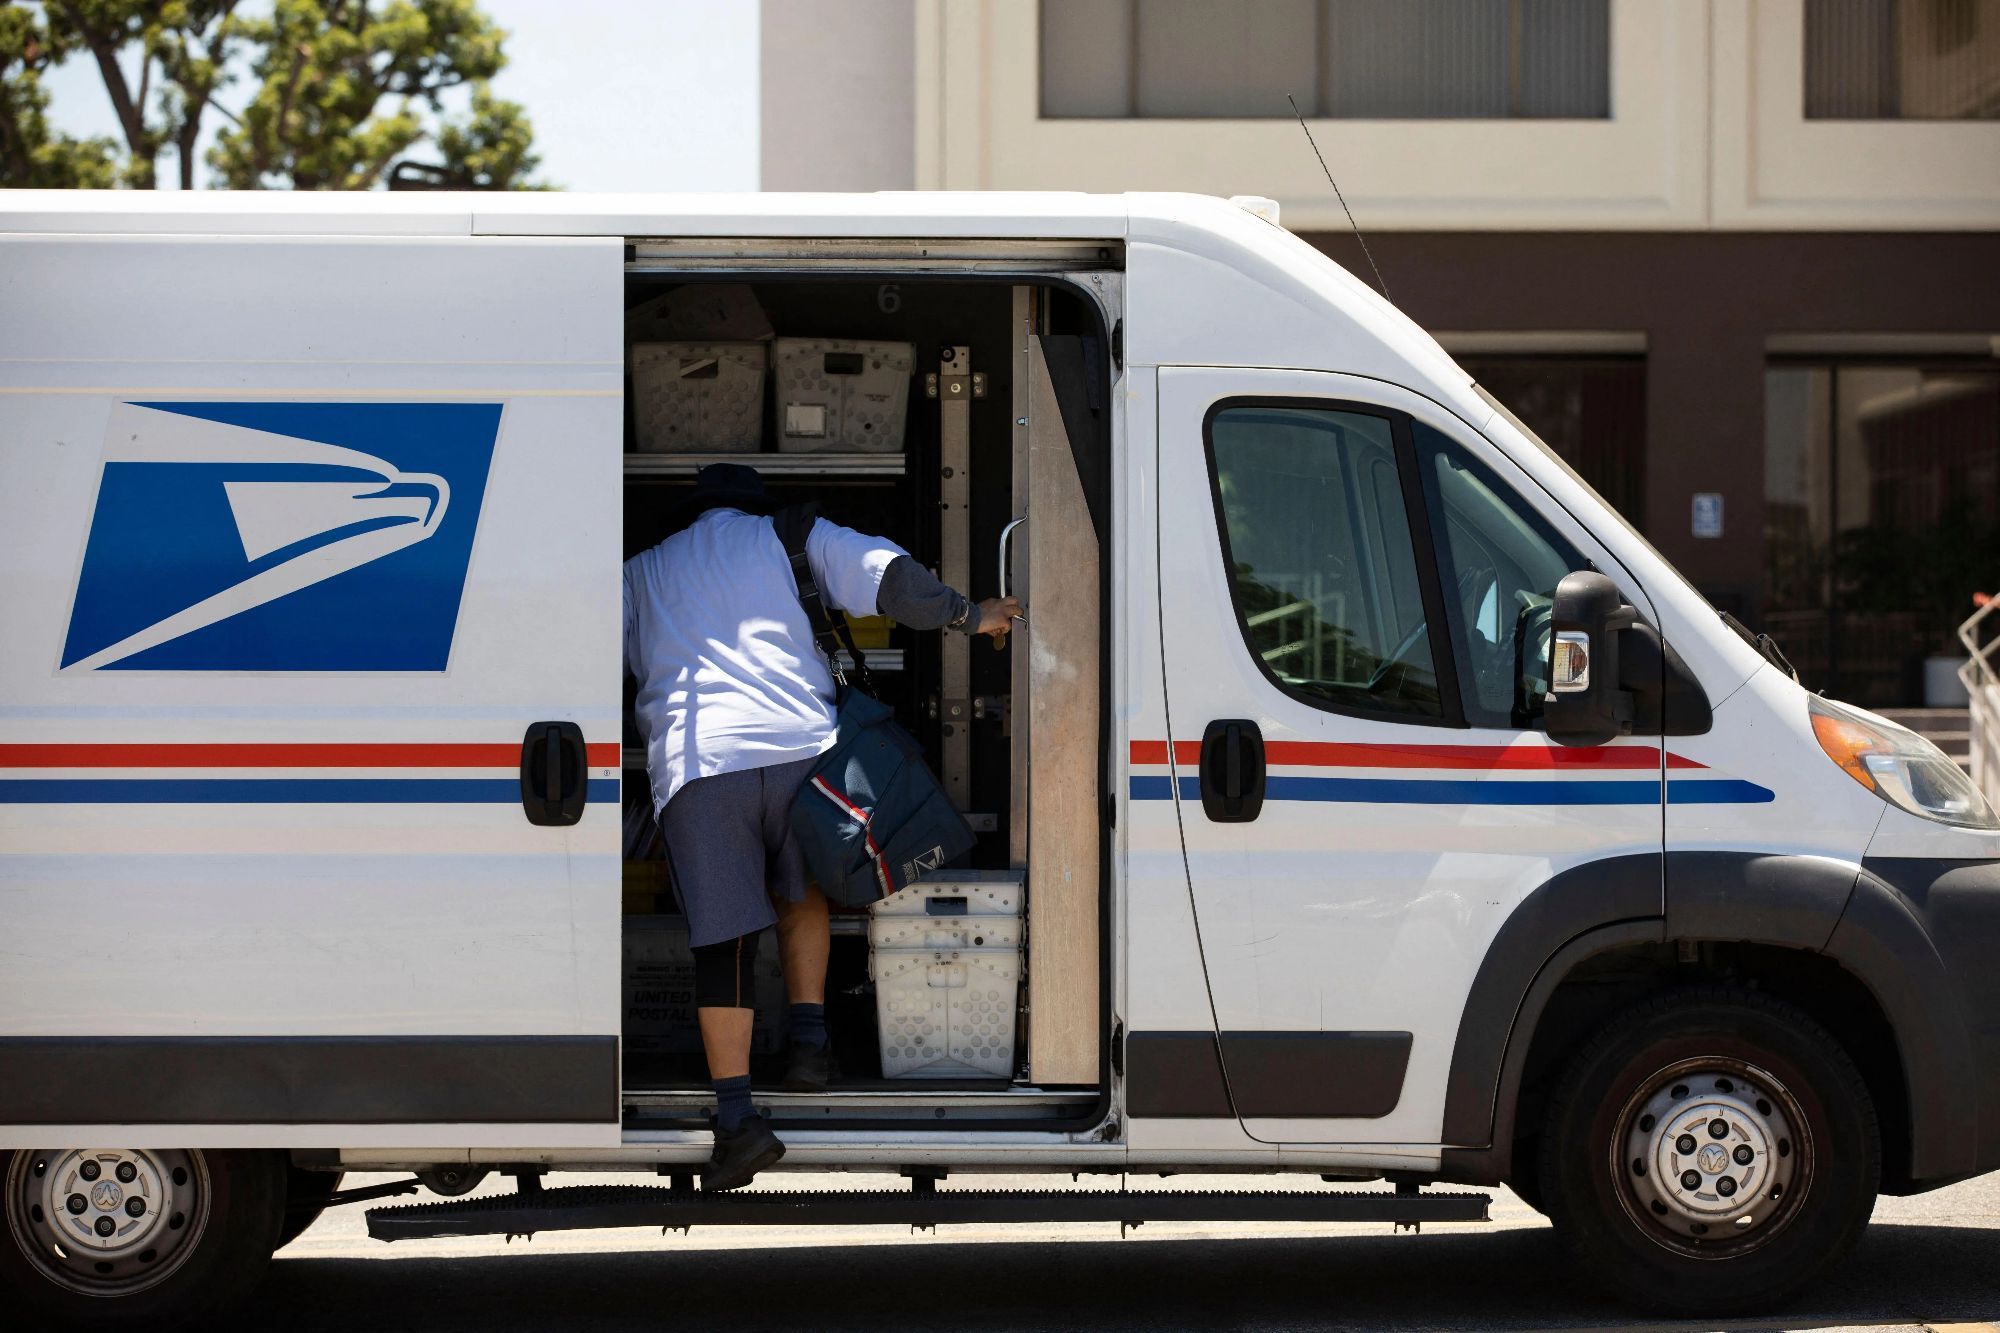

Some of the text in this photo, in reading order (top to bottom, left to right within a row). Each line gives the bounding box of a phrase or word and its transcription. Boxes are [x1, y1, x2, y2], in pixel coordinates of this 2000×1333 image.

[878, 284, 901, 314] 6
[634, 991, 691, 1004] UNITED
[628, 1007, 691, 1021] POSTAL
